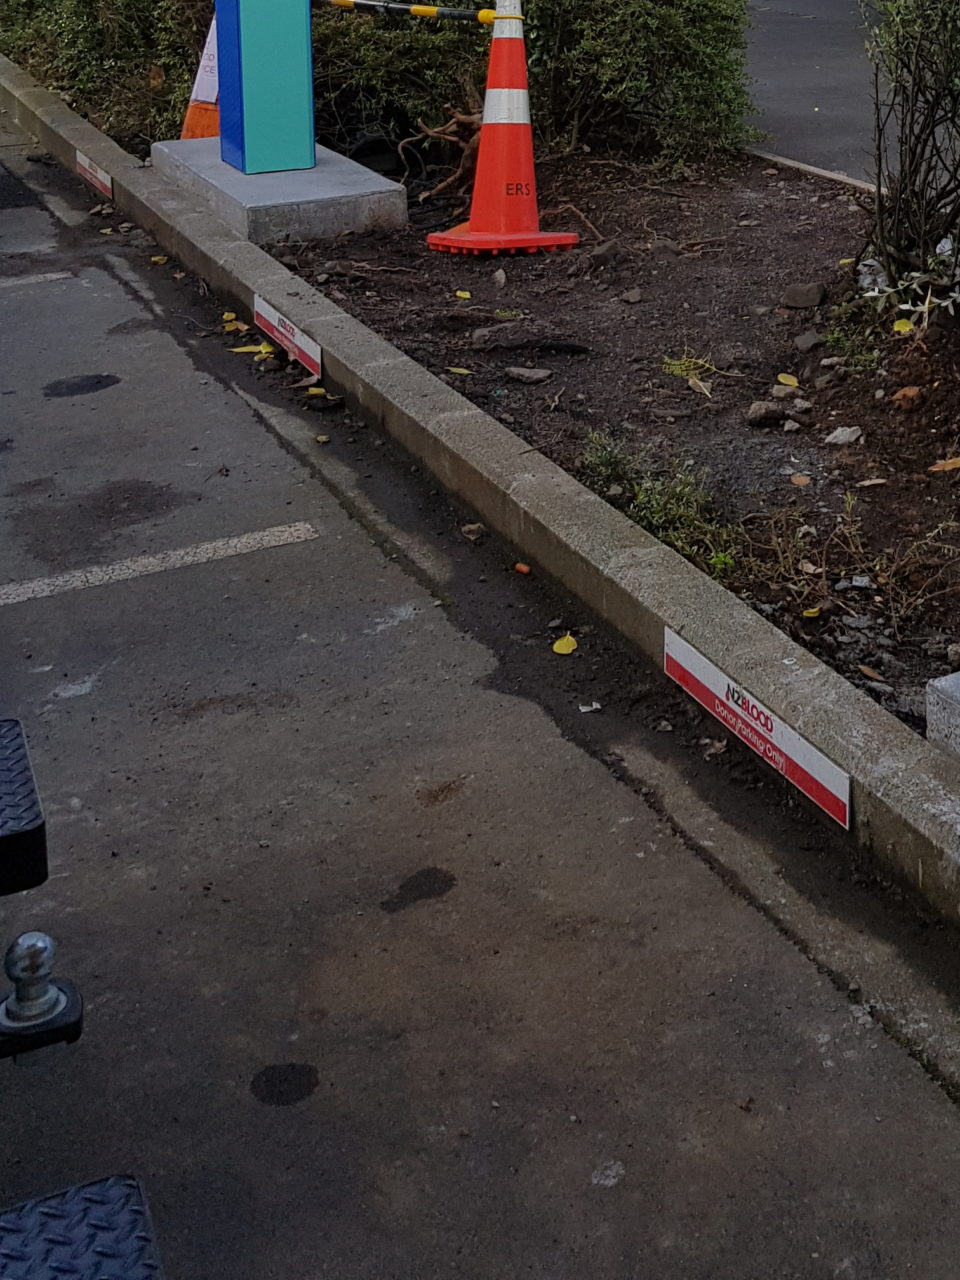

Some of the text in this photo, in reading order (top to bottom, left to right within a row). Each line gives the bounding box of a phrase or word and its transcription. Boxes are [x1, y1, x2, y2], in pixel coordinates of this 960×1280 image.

[506, 182, 530, 196] ERS
[714, 700, 739, 726] Donor
[735, 719, 764, 753] Parking
[726, 683, 774, 734] NZBLOOD
